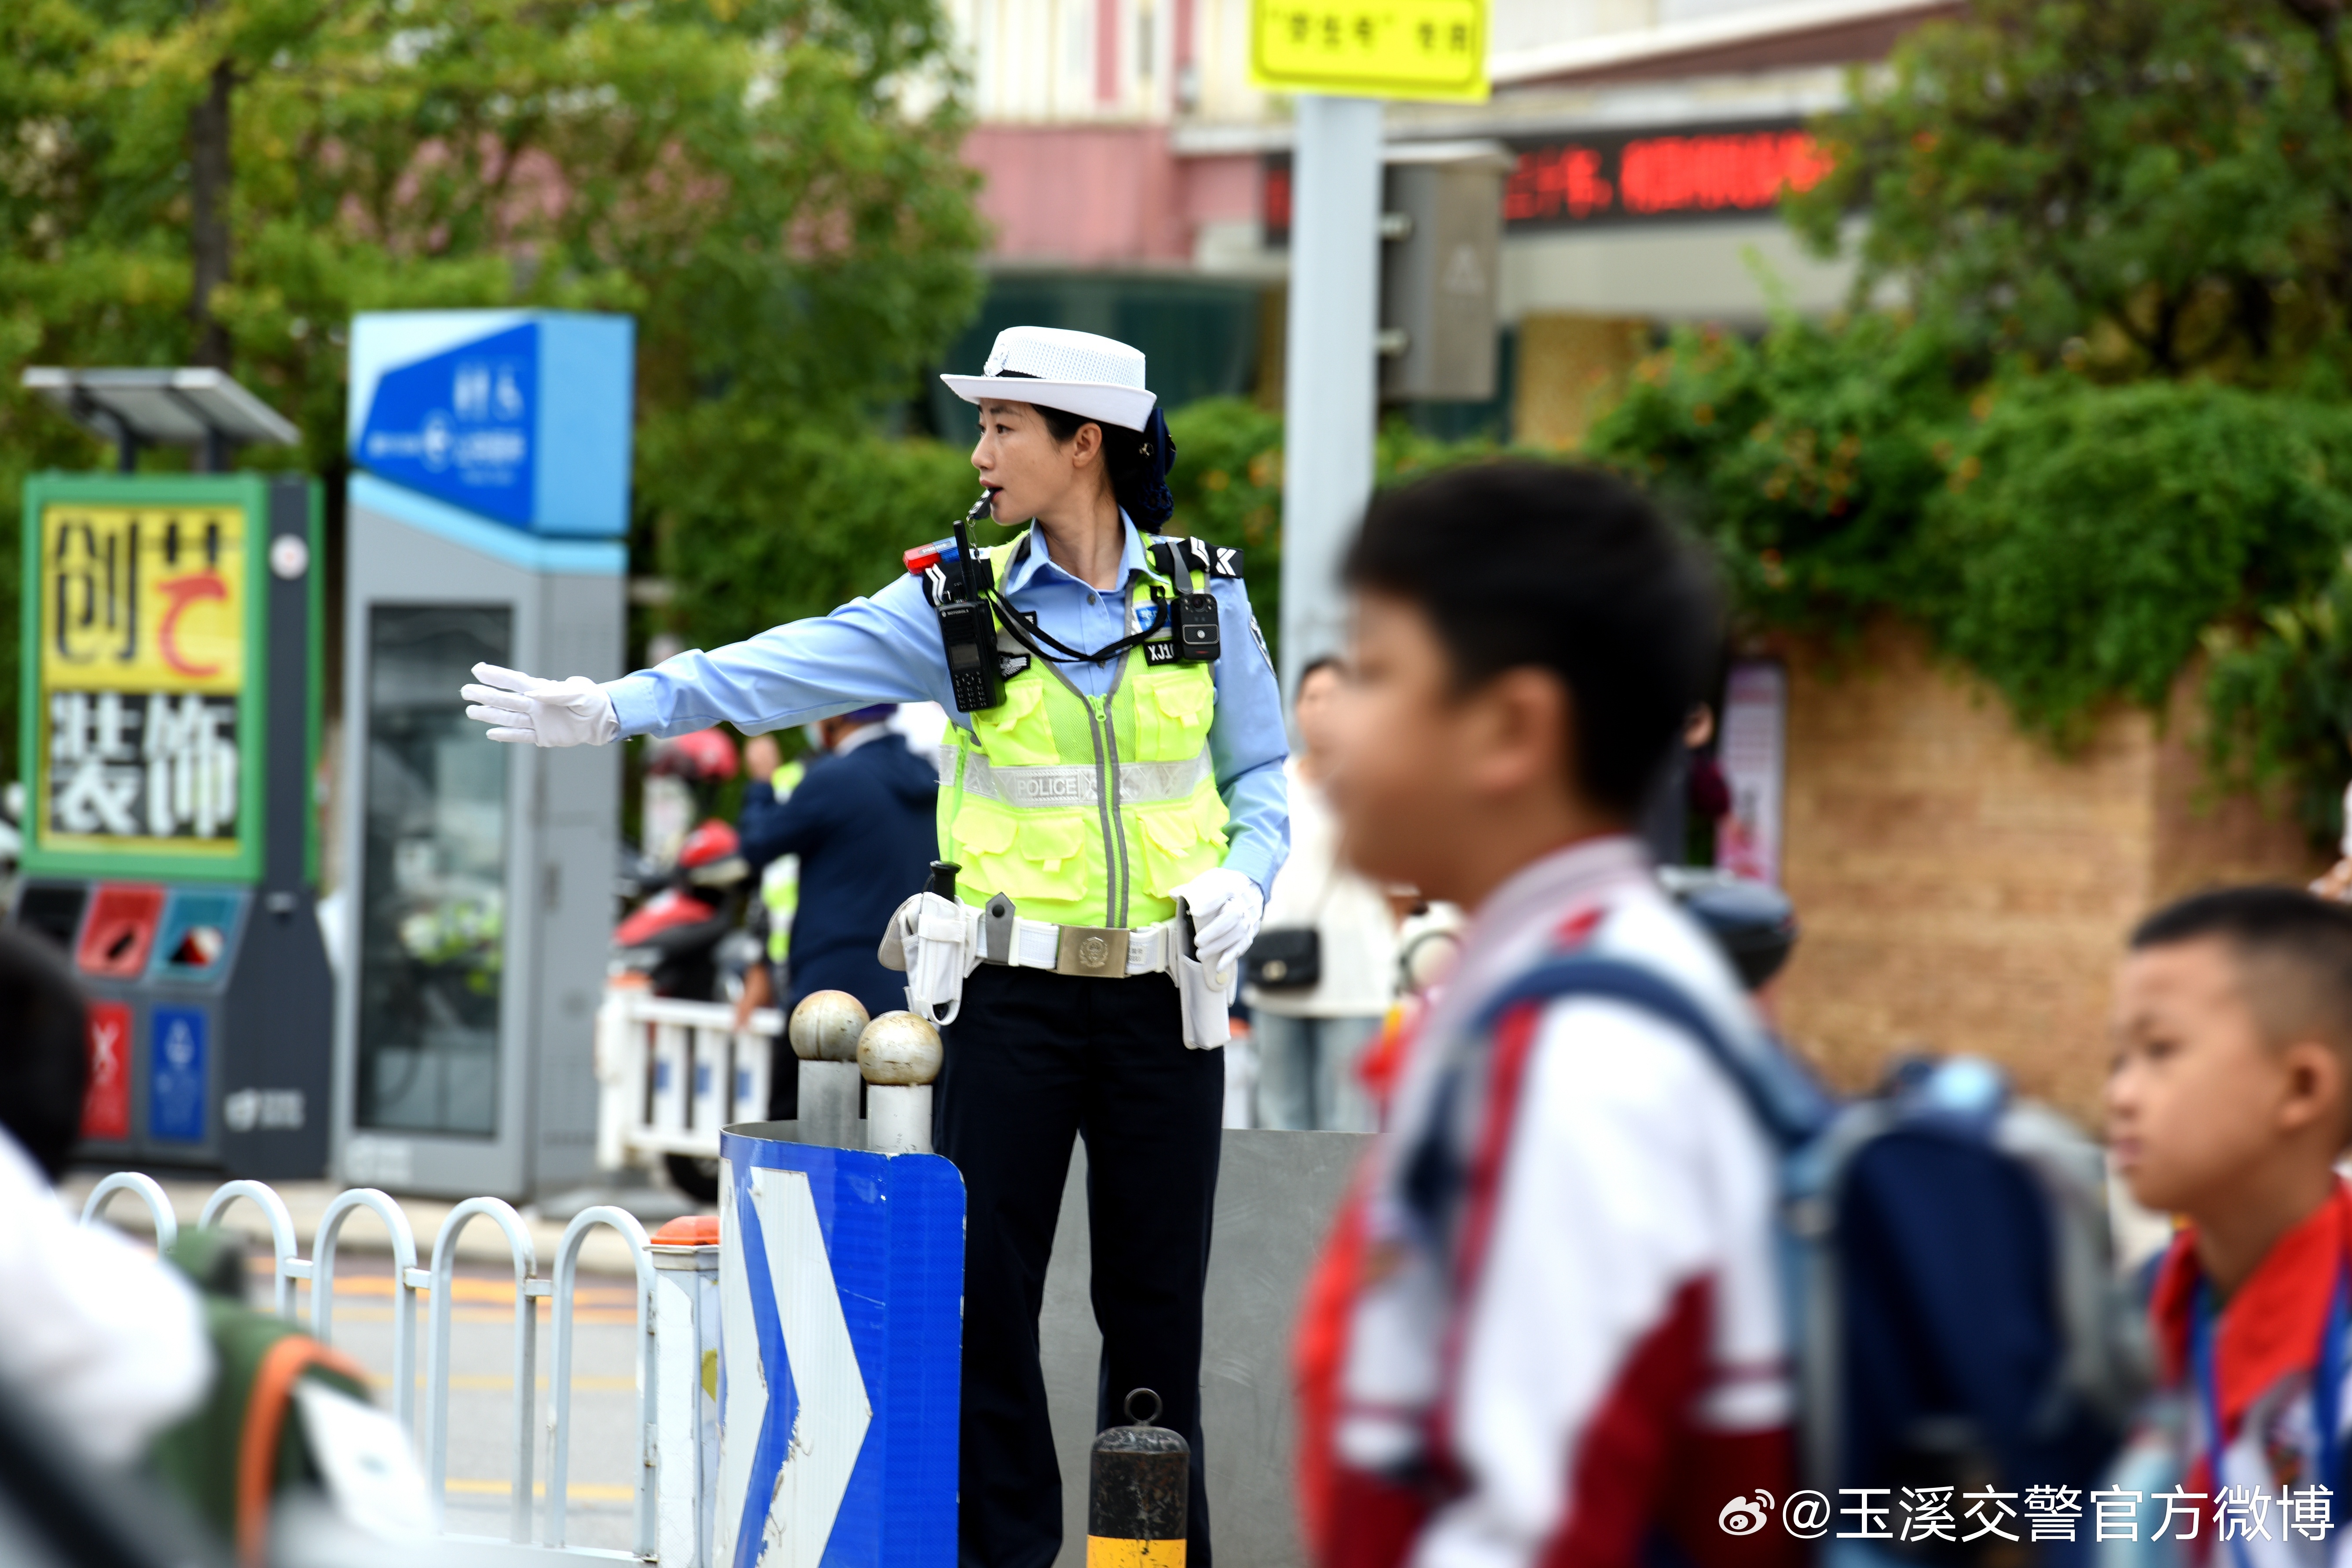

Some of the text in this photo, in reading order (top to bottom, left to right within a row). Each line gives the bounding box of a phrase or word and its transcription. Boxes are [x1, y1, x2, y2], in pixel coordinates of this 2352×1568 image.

[54, 520, 242, 677] 创艺
[50, 690, 238, 837] 装饰
[1016, 777, 1078, 797] POLICE
